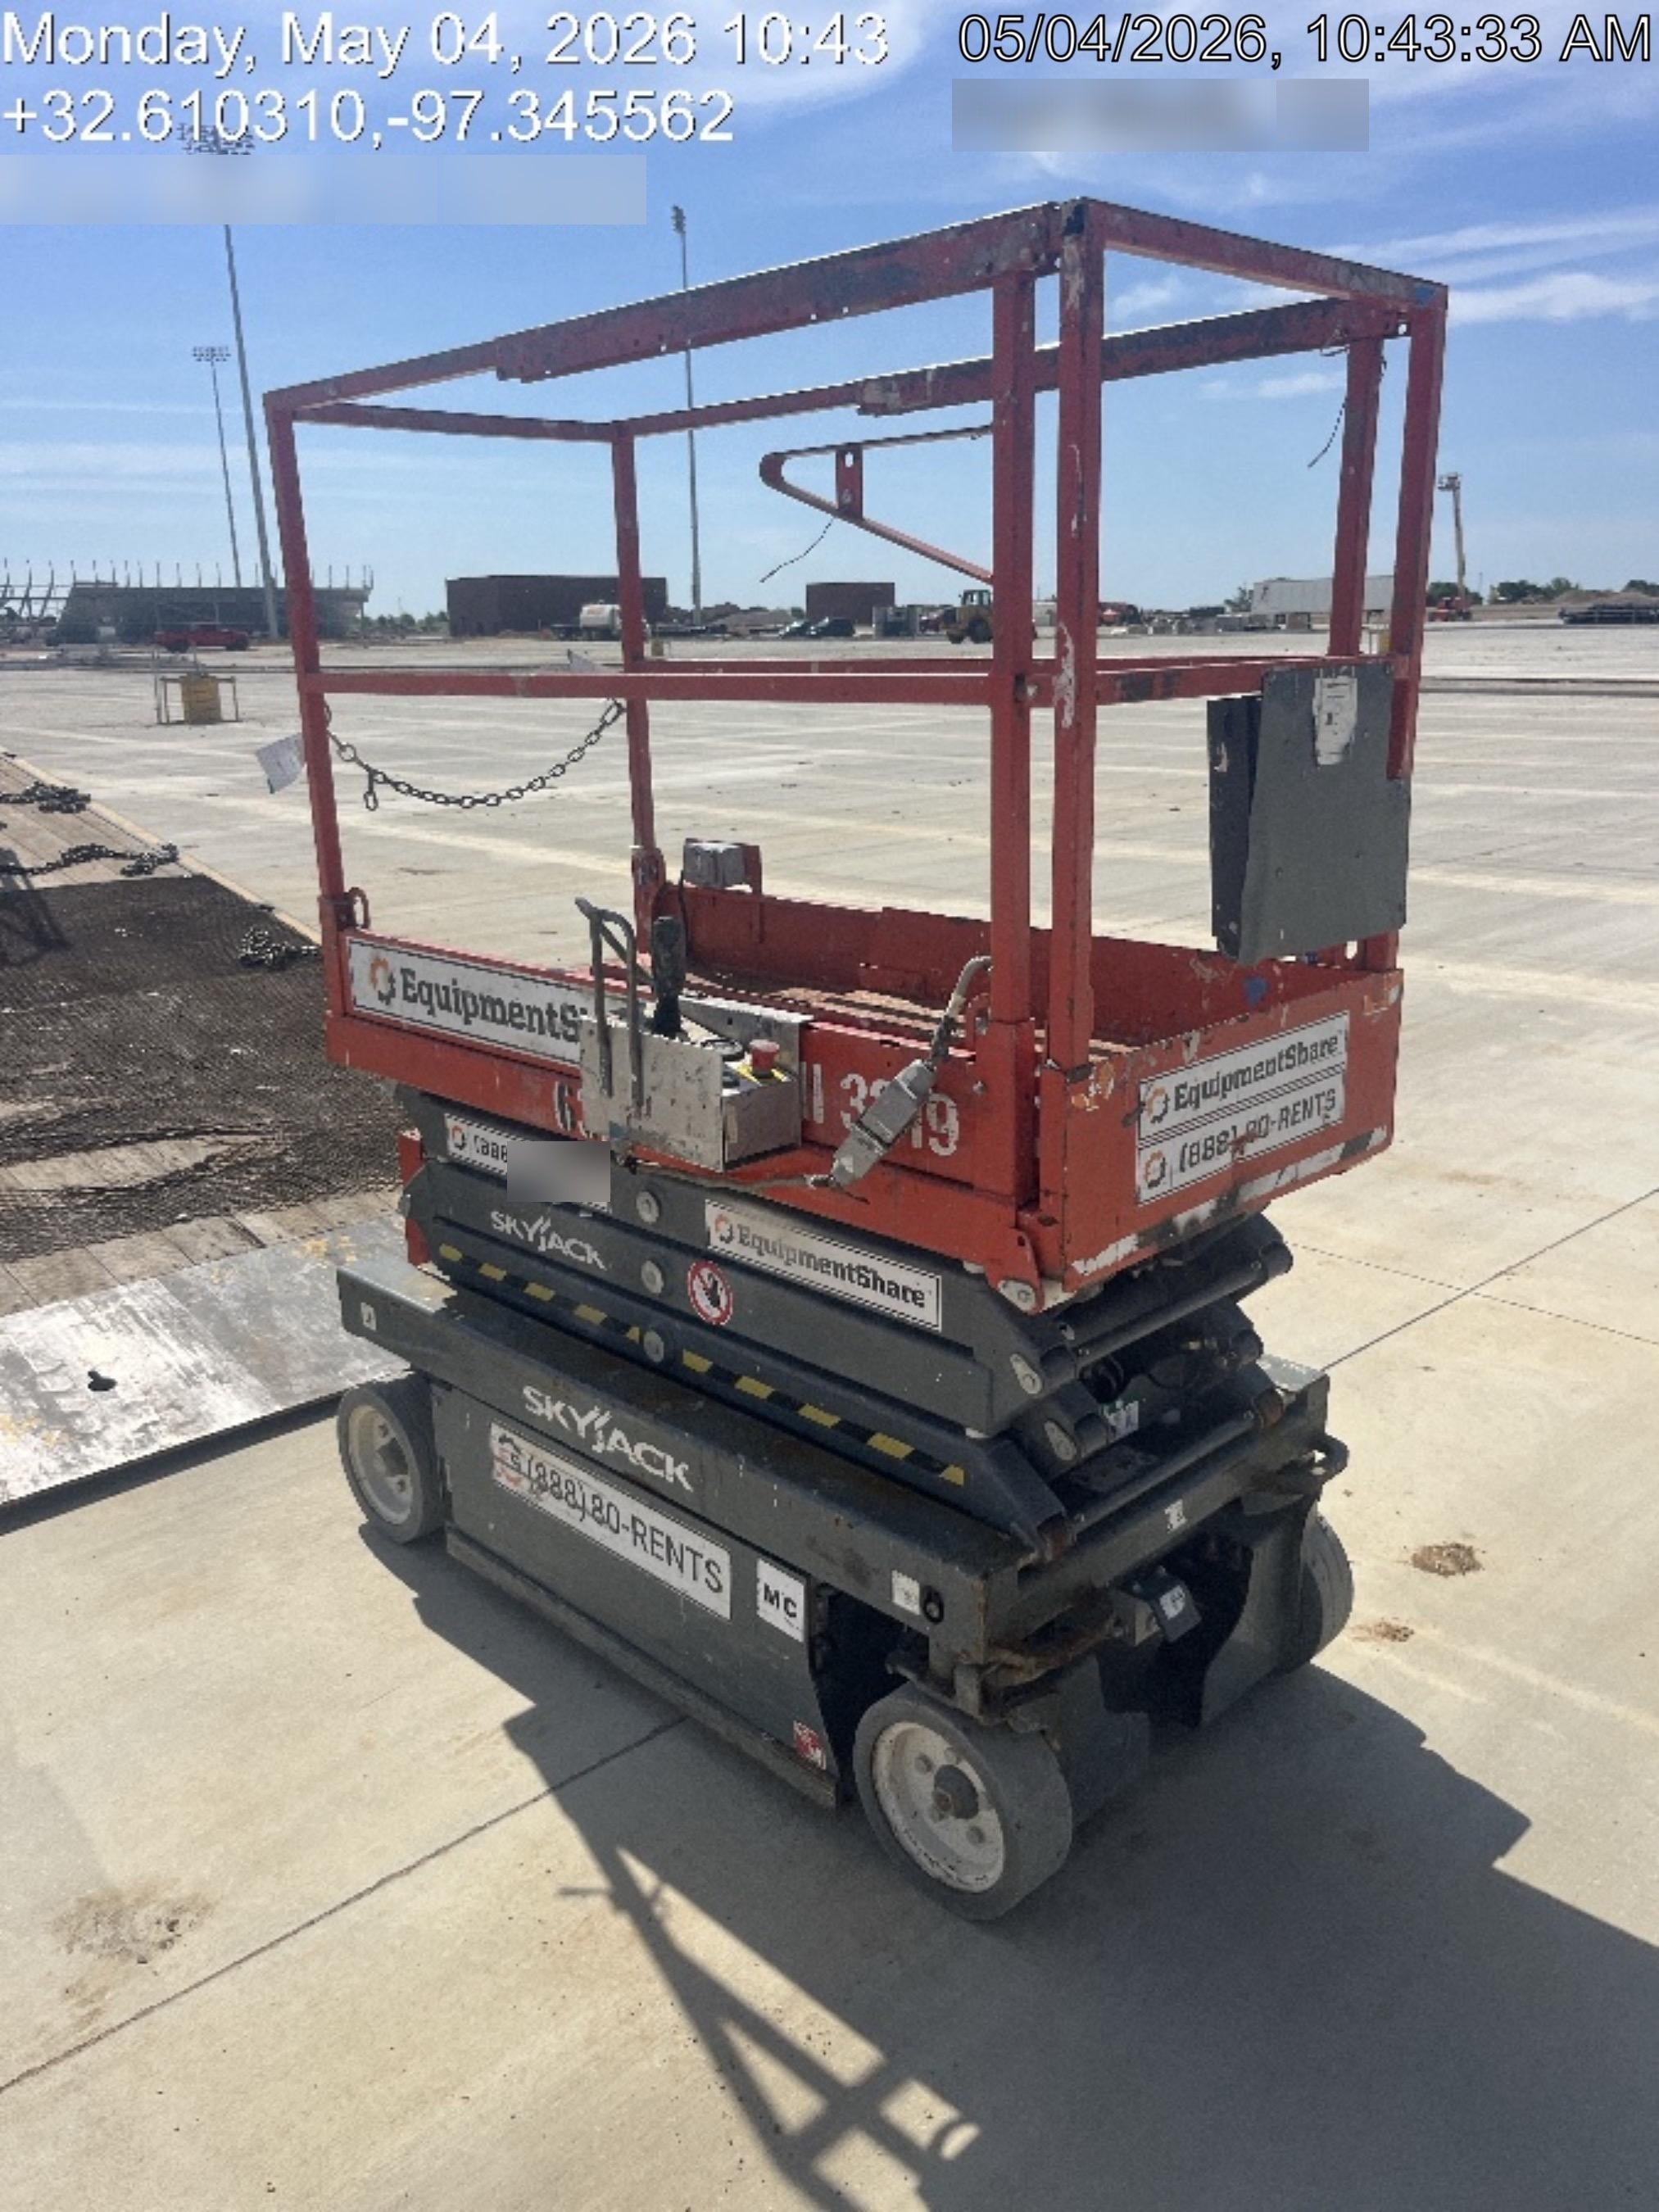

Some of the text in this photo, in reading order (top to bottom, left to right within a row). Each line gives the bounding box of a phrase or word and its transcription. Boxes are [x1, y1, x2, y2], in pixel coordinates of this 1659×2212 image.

[400, 967, 587, 1043] EquipmentS
[1174, 1035, 1339, 1111] EquipmentShare
[492, 1210, 608, 1271] SKYJACK
[737, 1222, 926, 1309] EquipmentShare
[522, 1385, 693, 1493] SKYJACK
